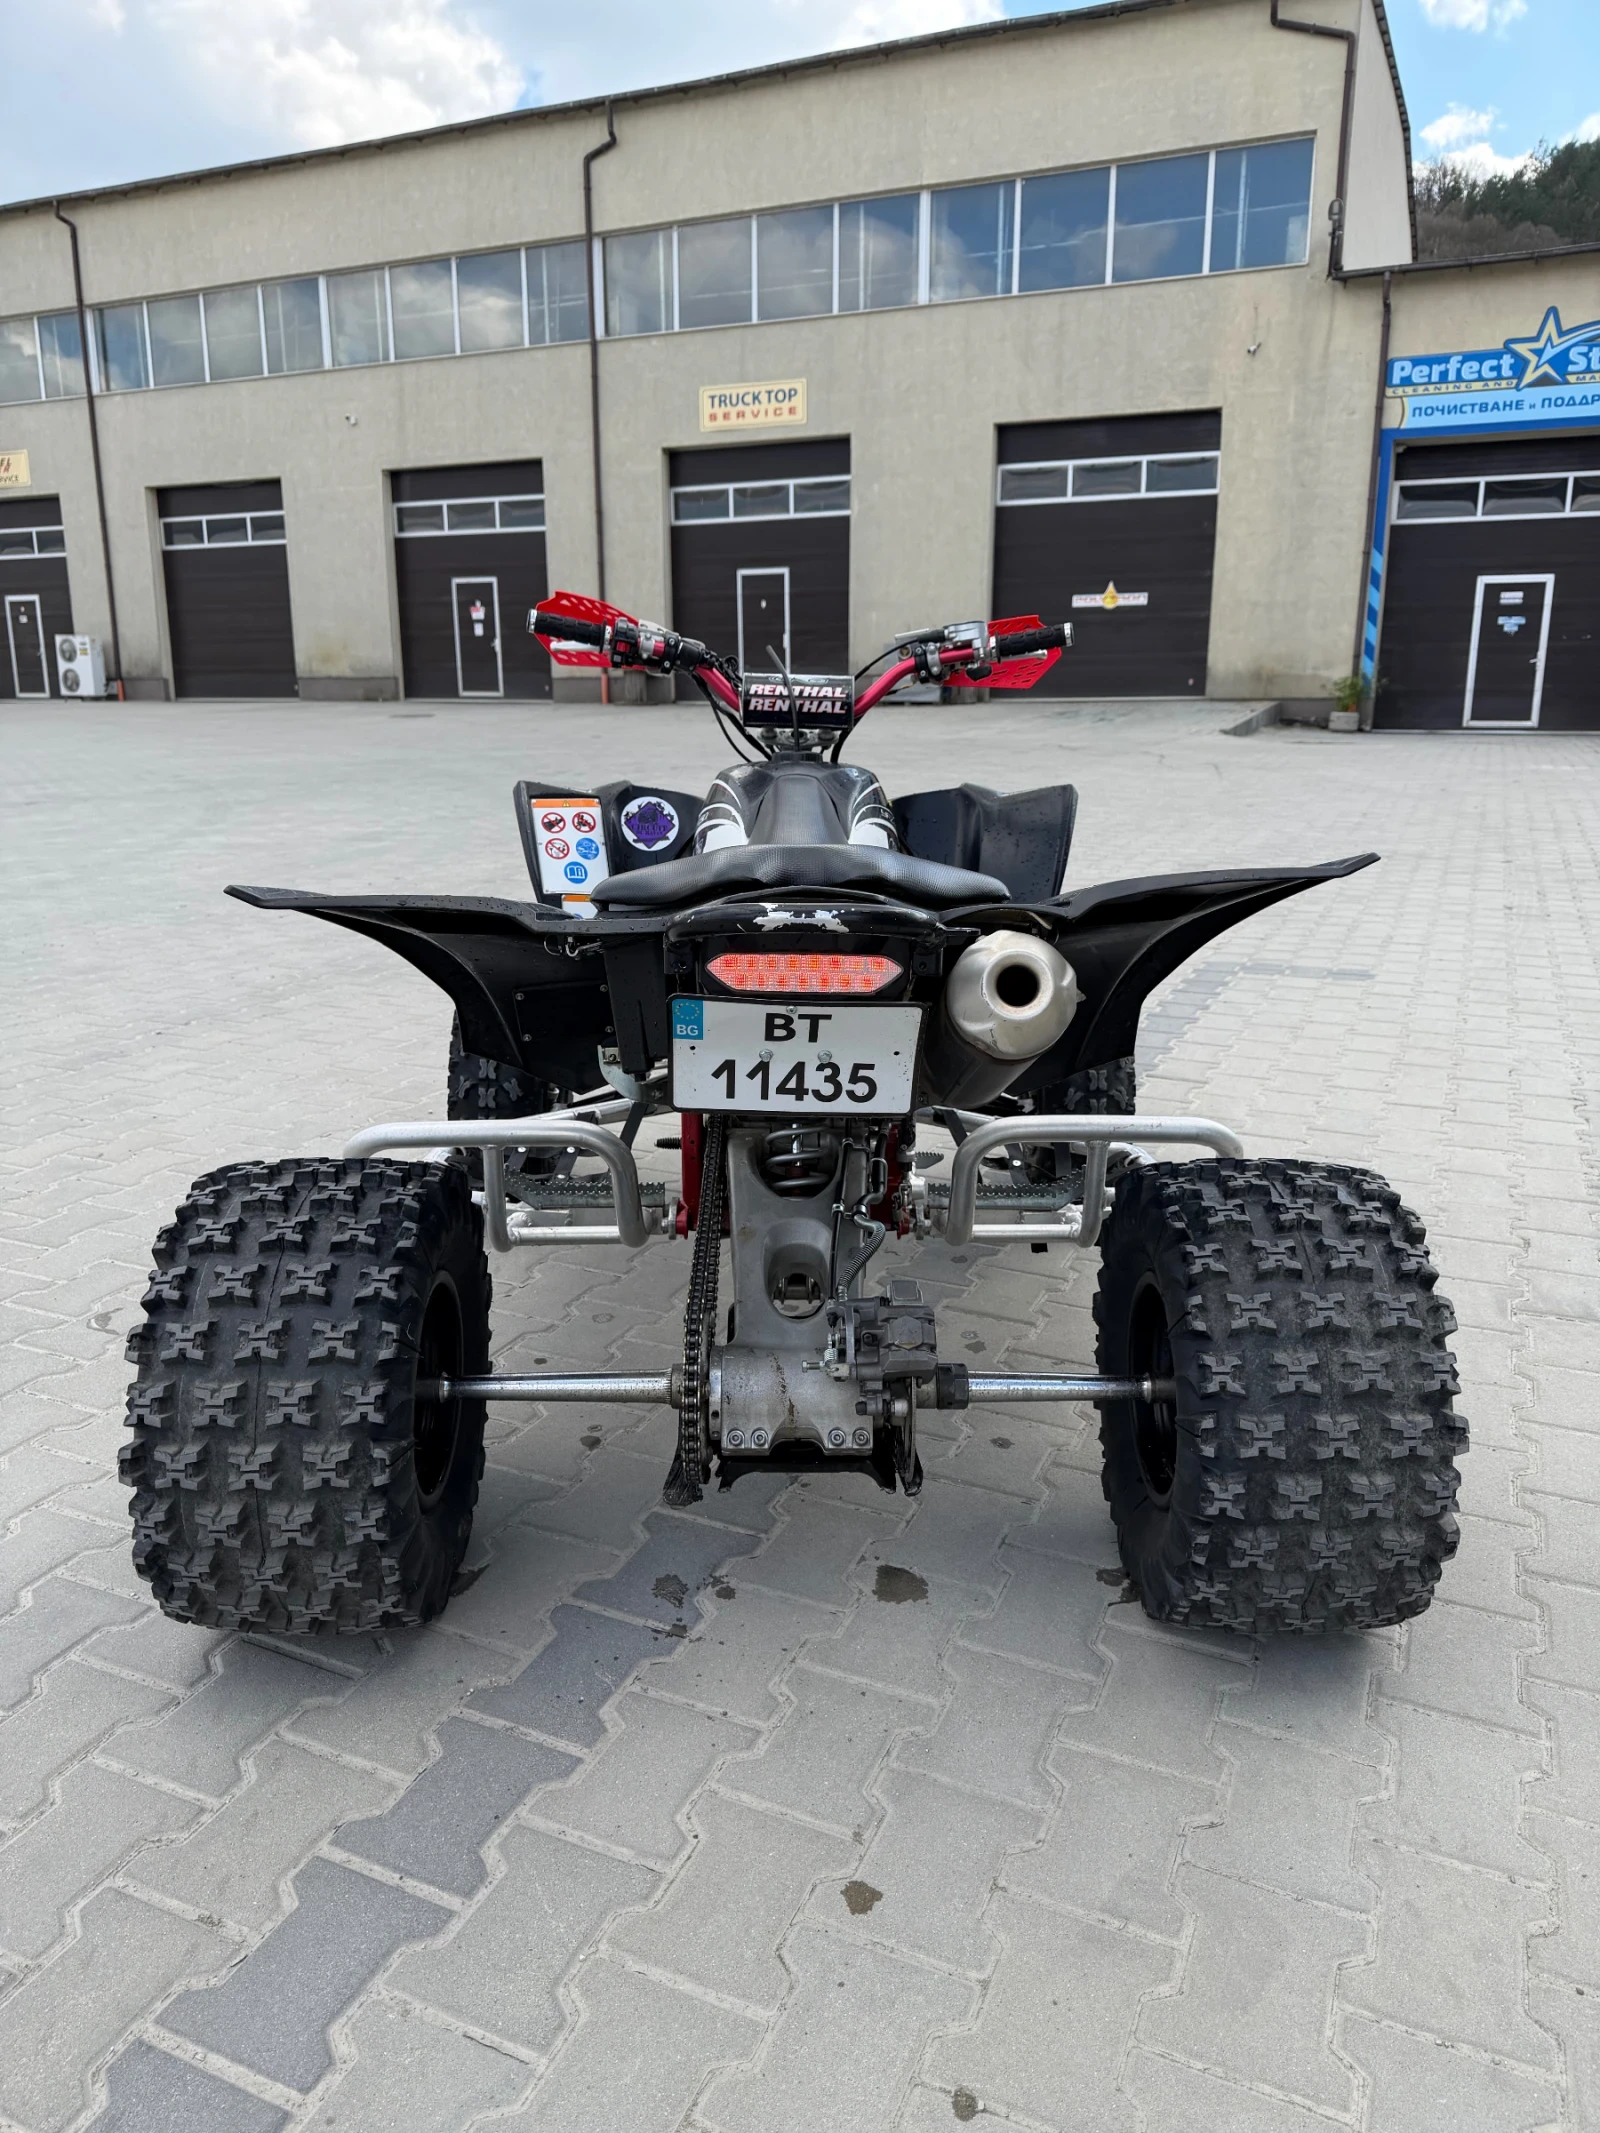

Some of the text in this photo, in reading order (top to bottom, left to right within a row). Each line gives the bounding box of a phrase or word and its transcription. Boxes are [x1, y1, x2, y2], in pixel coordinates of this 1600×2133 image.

[1392, 354, 1515, 385] Perfect
[1392, 382, 1473, 395] CLEANING
[1481, 380, 1515, 388] AND
[708, 387, 798, 409] TRUCK TOP
[708, 406, 798, 423] SERVICE
[1411, 399, 1525, 418] ПОЧИСТВАНЕ
[749, 683, 847, 698] RENTHAL
[676, 1024, 699, 1036] BG
[764, 1012, 833, 1043] BT
[711, 1058, 878, 1103] 11435
